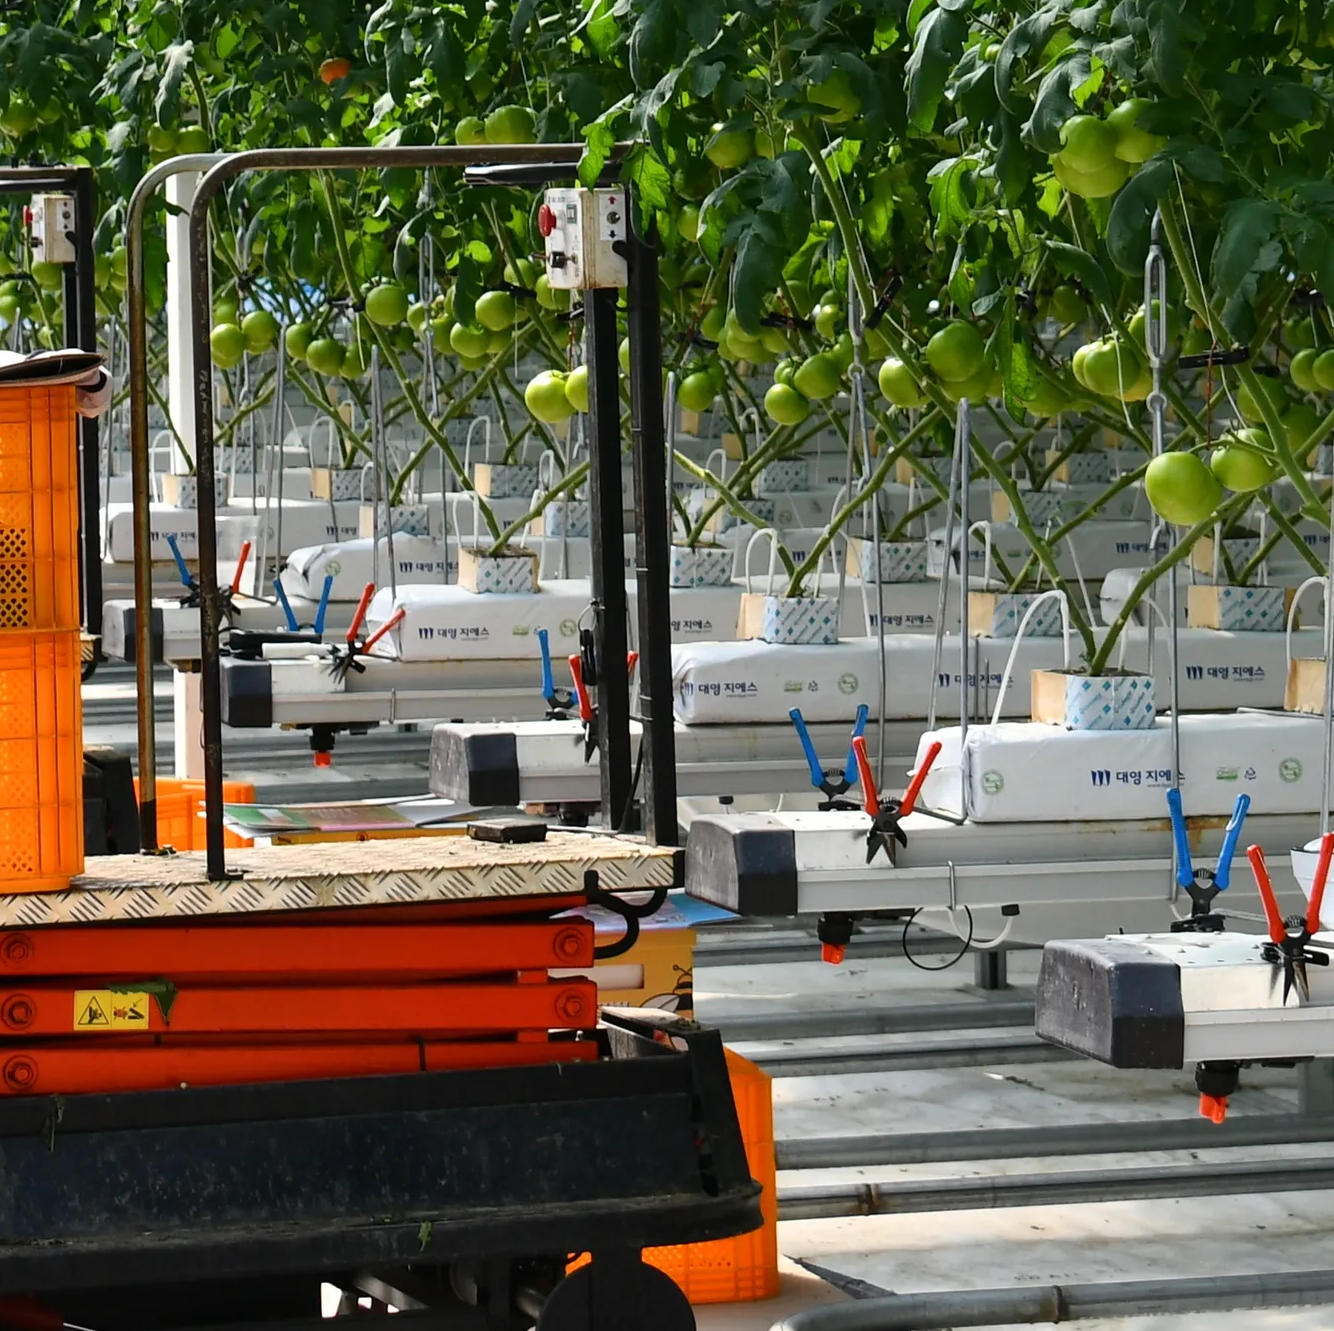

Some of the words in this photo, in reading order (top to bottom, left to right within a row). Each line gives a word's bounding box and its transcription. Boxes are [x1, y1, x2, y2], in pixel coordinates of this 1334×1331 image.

[1207, 666, 1229, 680] 대영
[1232, 665, 1266, 678] 지에스
[698, 683, 721, 696] 대영
[724, 681, 758, 693] 지에스
[1116, 770, 1142, 786] 대영
